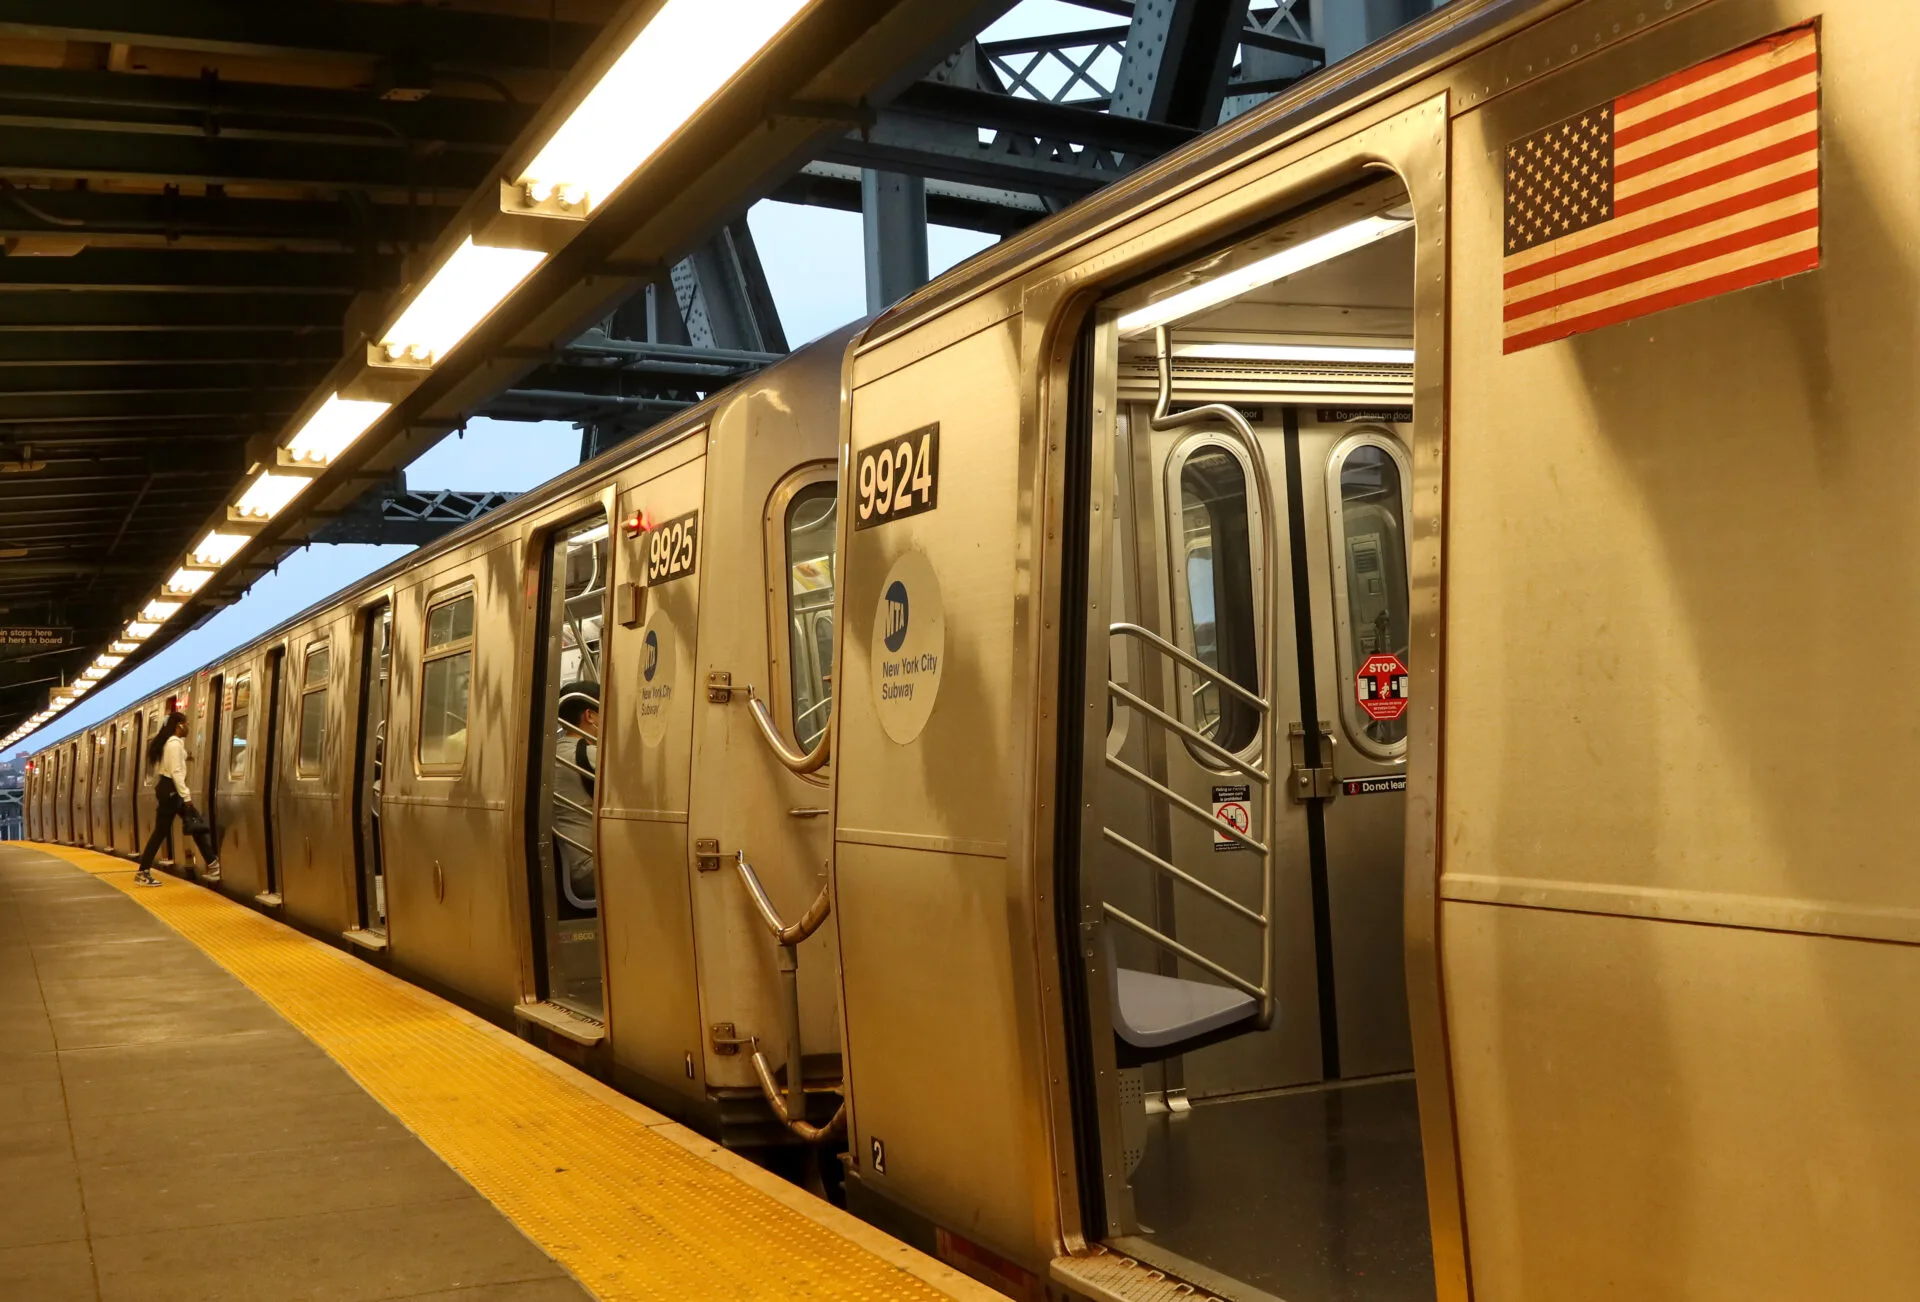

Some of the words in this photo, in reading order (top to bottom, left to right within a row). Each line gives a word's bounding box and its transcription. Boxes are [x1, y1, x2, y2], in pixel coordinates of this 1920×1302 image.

[1336, 411, 1347, 420] Do
[859, 433, 933, 521] 9924
[650, 517, 694, 580] 9925
[885, 600, 905, 638] MTA
[8, 636, 26, 644] here
[40, 636, 63, 644] board
[10, 629, 32, 638] stops
[35, 629, 52, 637] here
[883, 661, 900, 678] New
[901, 657, 919, 675] York
[921, 653, 938, 674] City
[1369, 662, 1397, 673] STOP
[882, 682, 914, 701] Subway
[1362, 782, 1374, 792] Do
[1375, 782, 1389, 790] not
[686, 1052, 692, 1077] 1
[874, 1141, 884, 1172] 2
